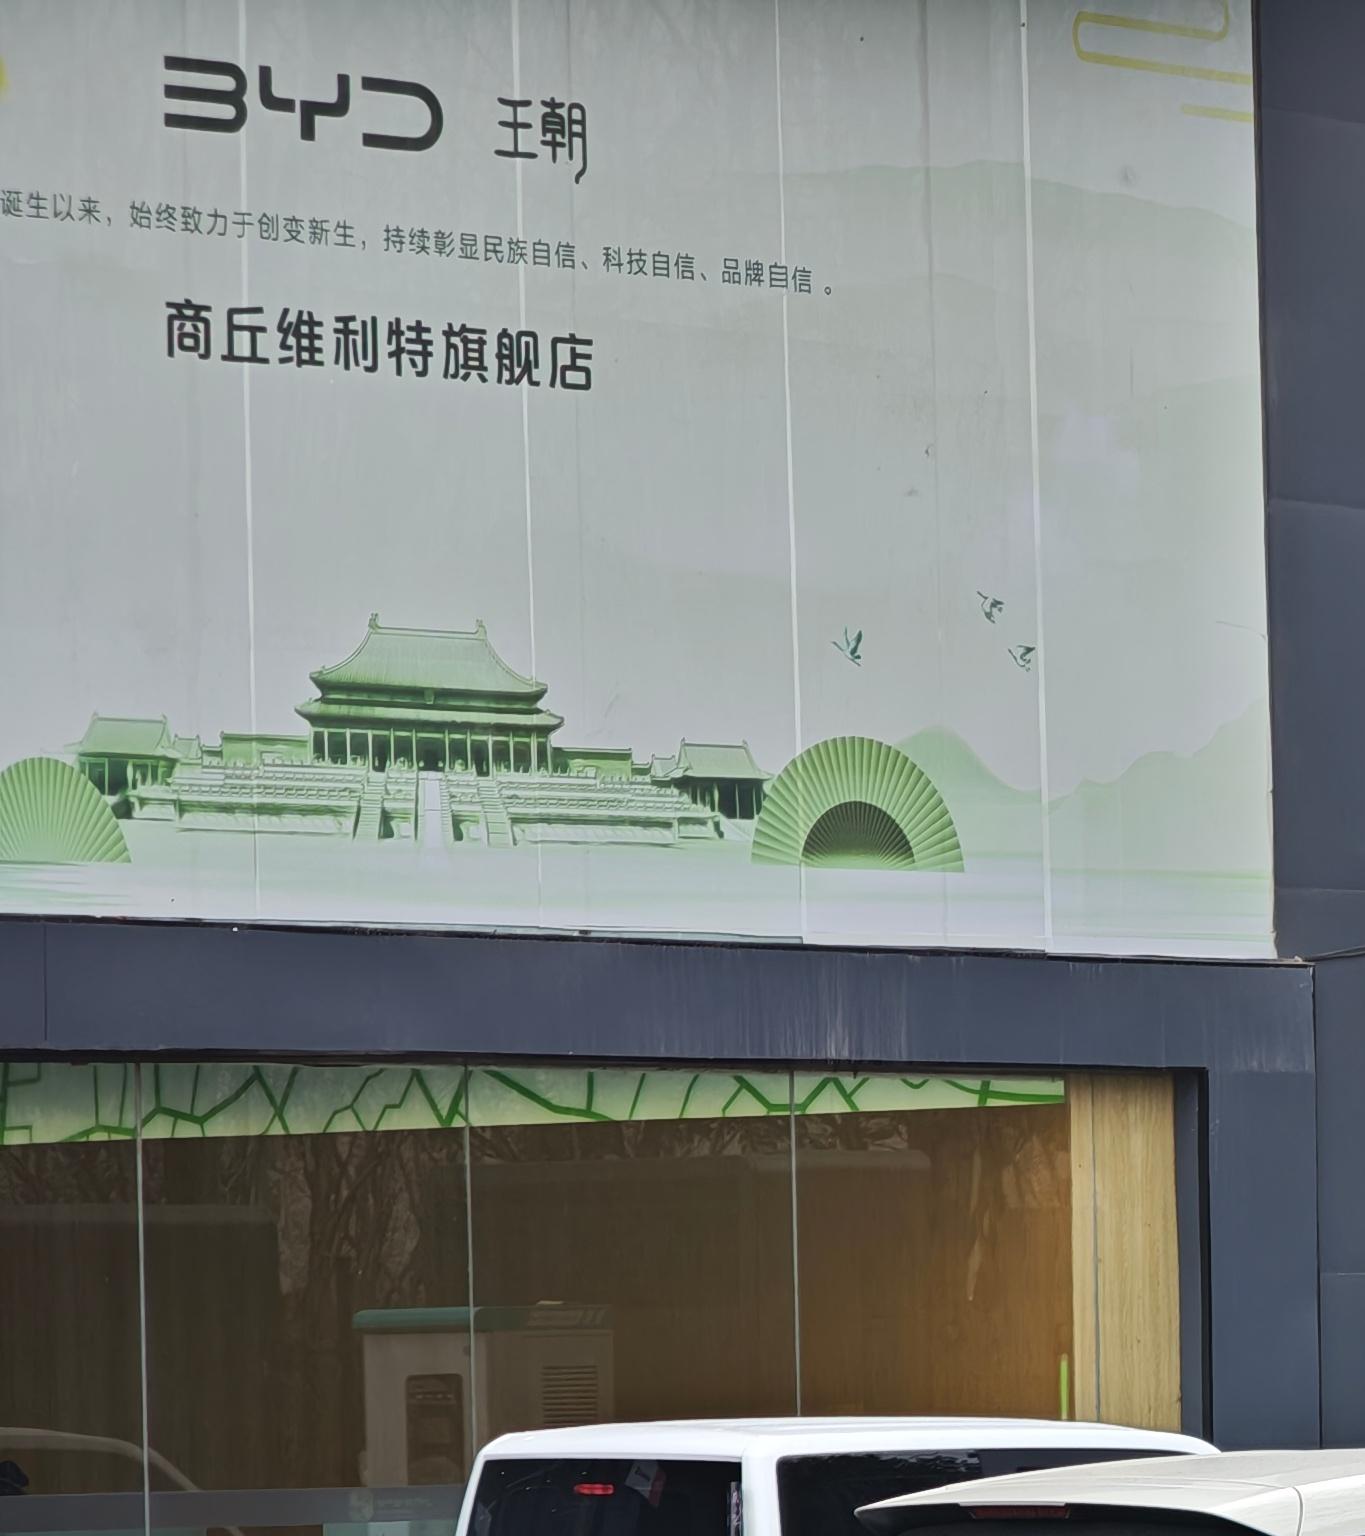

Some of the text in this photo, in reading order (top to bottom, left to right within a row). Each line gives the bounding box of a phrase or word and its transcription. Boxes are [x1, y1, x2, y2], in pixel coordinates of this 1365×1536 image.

[164, 55, 444, 153] BYD
[493, 96, 588, 185] 王朝
[164, 299, 595, 392] 商丘维利特旗舰店
